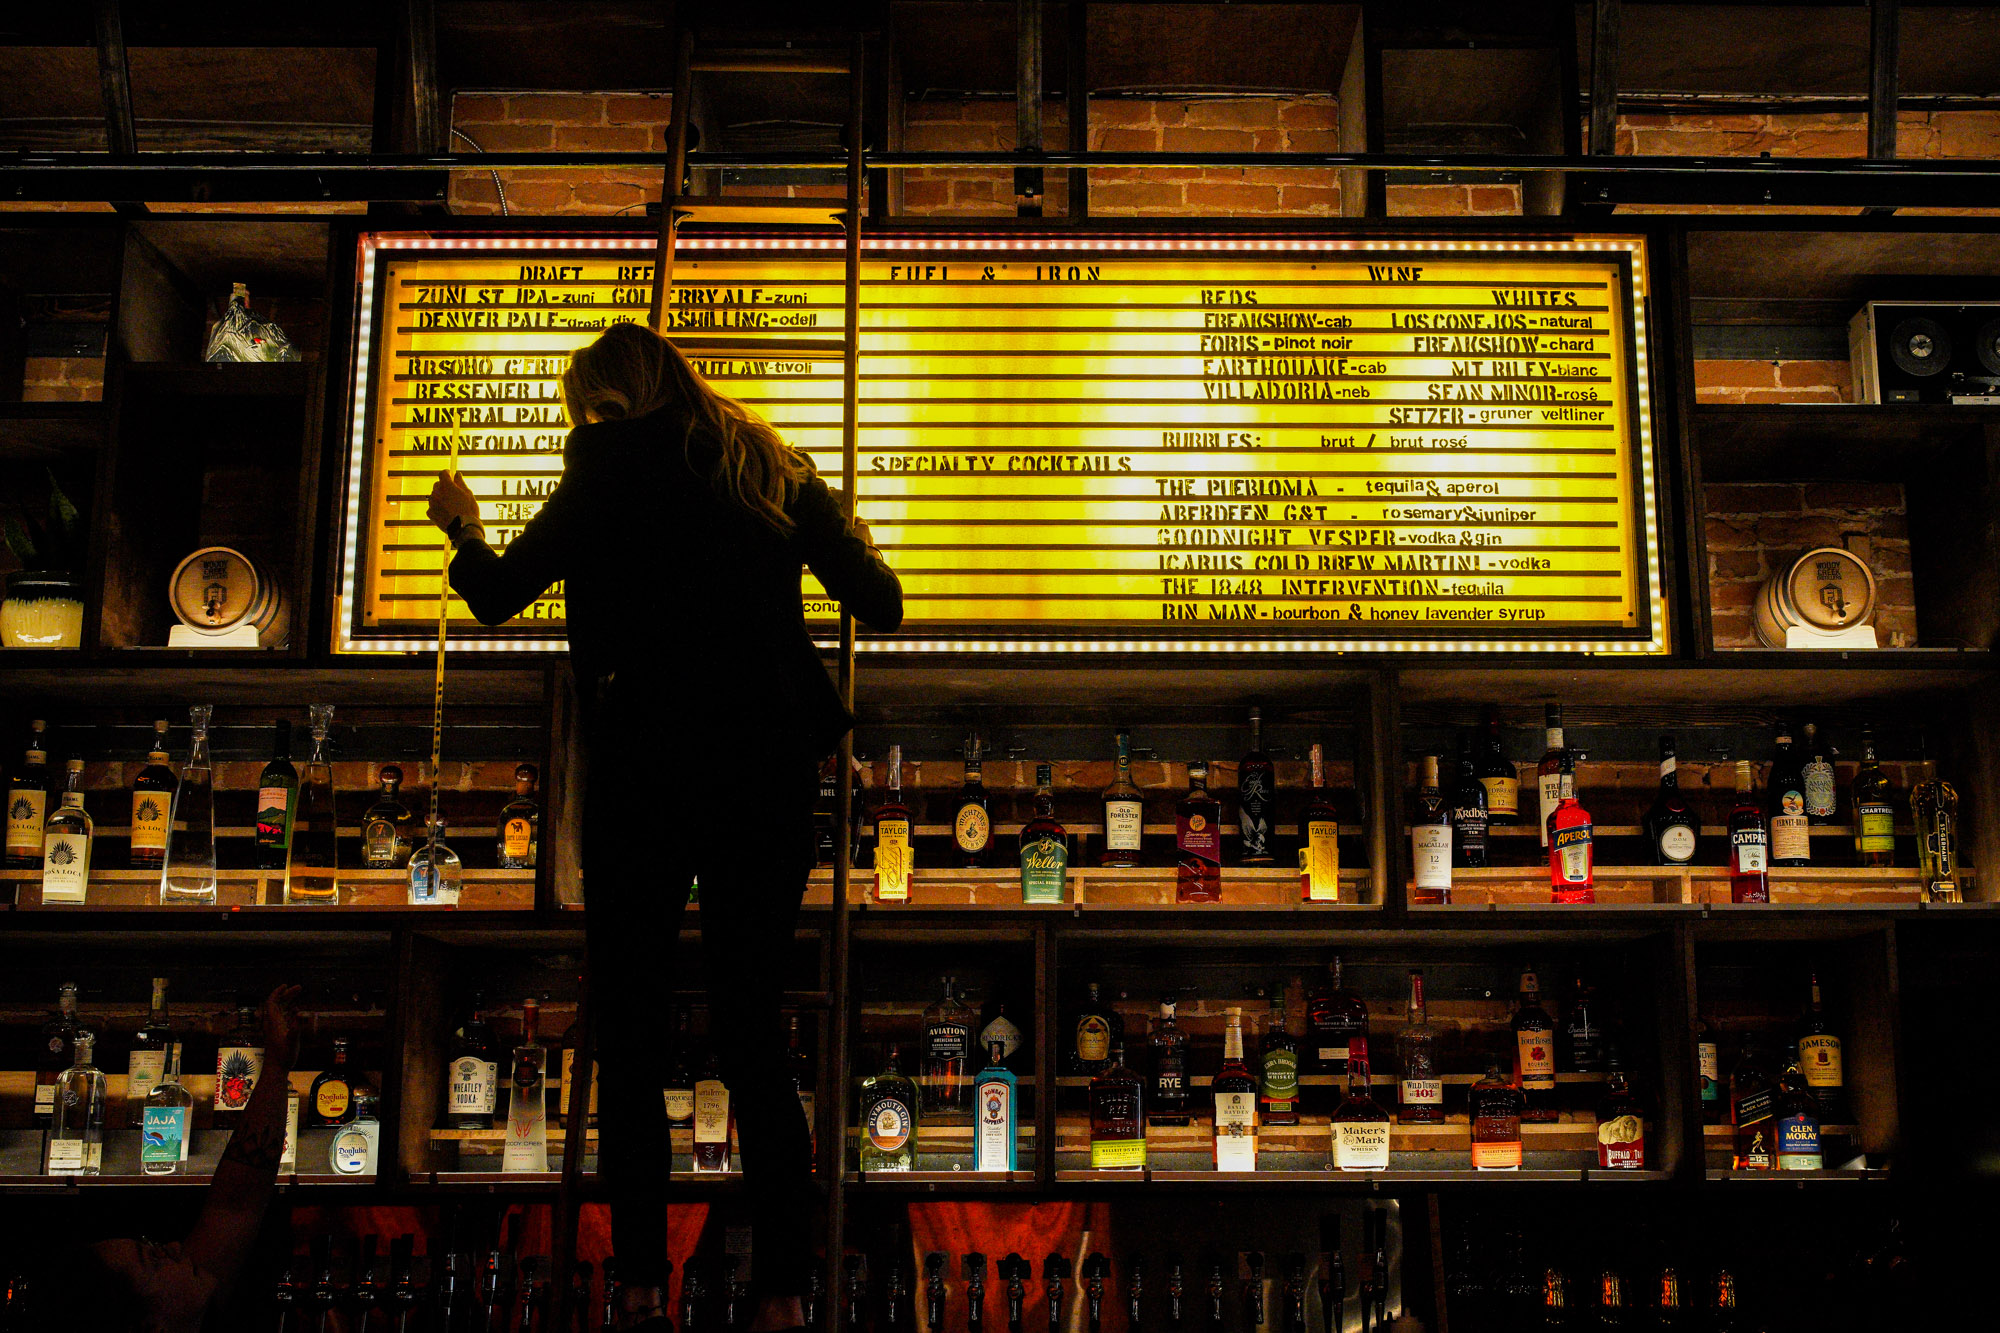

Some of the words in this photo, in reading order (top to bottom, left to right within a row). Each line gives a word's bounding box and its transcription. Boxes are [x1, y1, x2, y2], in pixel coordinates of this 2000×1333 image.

[520, 266, 583, 280] DRAFT
[891, 266, 948, 280] FUEL
[981, 266, 995, 280] &
[1036, 266, 1100, 280] IRON
[1368, 266, 1421, 281] WINE
[417, 286, 466, 304] ZUNI
[477, 289, 504, 304] ST
[1201, 290, 1258, 304] REDS
[1491, 290, 1578, 306] WHITES
[419, 312, 498, 328] DENVER
[1320, 336, 1354, 350] noir
[1451, 361, 1484, 377] MT
[416, 382, 530, 398] BESSEMER
[1428, 384, 1484, 401] SEAN
[413, 407, 508, 423] MINERAL
[1541, 407, 1605, 422] veltliner
[1320, 433, 1355, 448] brut
[1390, 434, 1423, 448] brut
[1432, 434, 1468, 448] rosé
[871, 456, 995, 471] SPECIALTY
[1008, 456, 1133, 471] COCKTAILS
[1155, 479, 1194, 496] THE
[1446, 480, 1499, 496] aperol
[1159, 505, 1269, 520] ABERDEEN
[1284, 505, 1328, 521] G&T
[1157, 529, 1292, 545] GOODNIGHT
[1159, 554, 1243, 571] ICARUS
[1255, 554, 1310, 571] COLD
[1318, 554, 1375, 571] BREW
[1161, 578, 1199, 595] THE
[1211, 578, 1263, 595] 1848
[1162, 603, 1198, 620] BIN
[1348, 603, 1363, 620] &
[1370, 605, 1419, 621] honey
[1425, 604, 1493, 620] lavender
[1499, 604, 1546, 621] syrup
[880, 827, 908, 835] TAYLOR
[1310, 828, 1337, 836] TAYLOR
[1557, 829, 1591, 847] APEROL
[1026, 851, 1064, 870] Weller
[1429, 855, 1439, 863] 12
[929, 1027, 966, 1037] AVIATION
[1801, 1038, 1840, 1051] JAMESON
[453, 1083, 482, 1093] WHEATLEY
[1159, 1078, 1182, 1089] RYE
[1406, 1081, 1422, 1089] WILD
[1414, 1089, 1434, 1098] 101
[147, 1115, 177, 1125] JAJA
[869, 1101, 903, 1127] PLYMOUTH
[899, 1110, 909, 1127] GIN
[1342, 1126, 1386, 1135] Maker's
[1790, 1124, 1813, 1133] GLEN
[1355, 1136, 1386, 1145] Mark
[1785, 1132, 1817, 1141] MORAY
[1608, 1149, 1631, 1160] BUFFALO
[1799, 1158, 1808, 1166] 12
